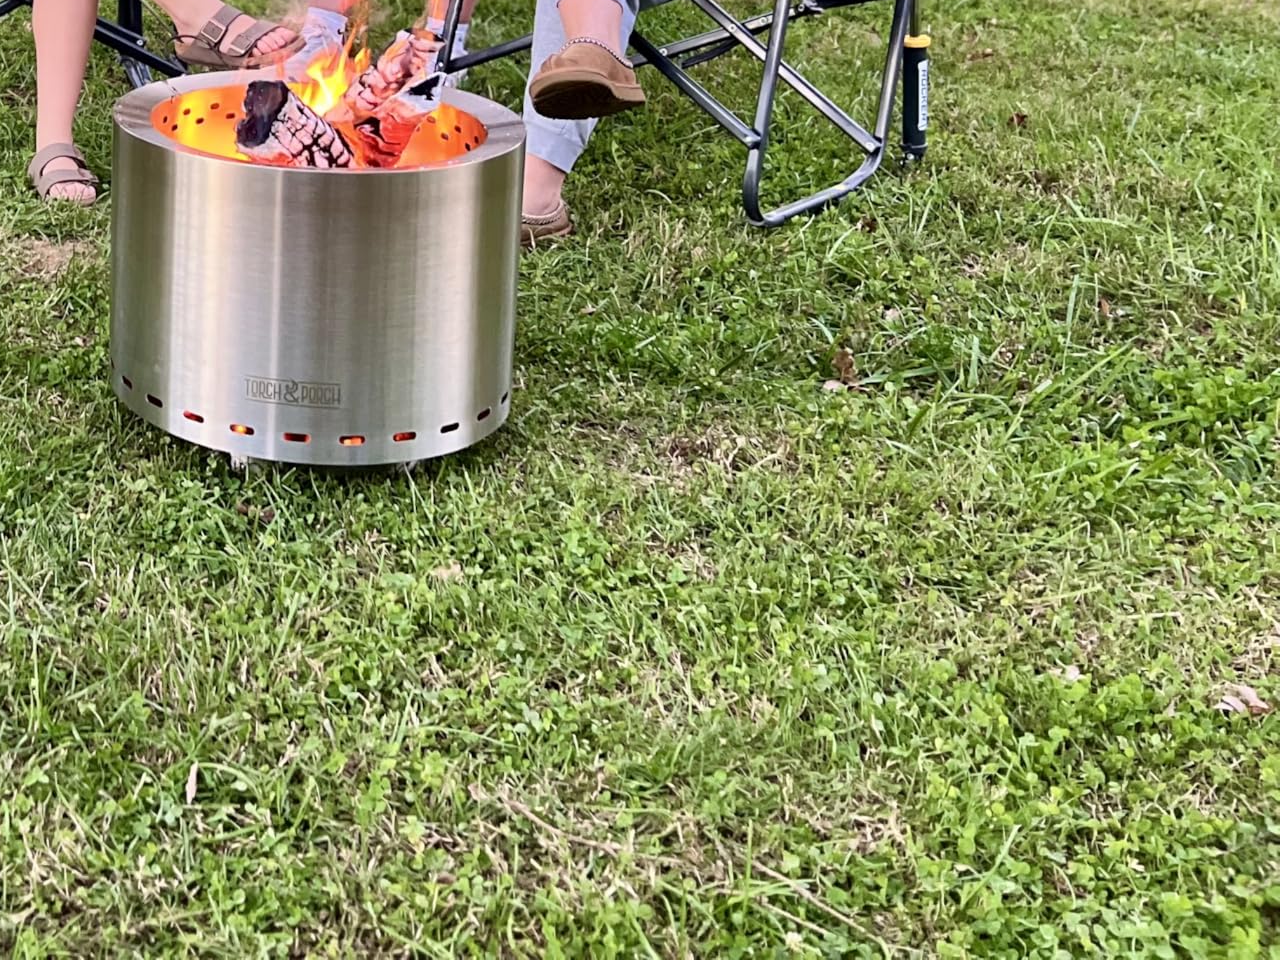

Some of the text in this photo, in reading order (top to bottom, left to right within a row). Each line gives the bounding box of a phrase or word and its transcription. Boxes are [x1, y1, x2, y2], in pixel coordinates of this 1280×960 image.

[244, 378, 341, 405] TORCH & PORCH
